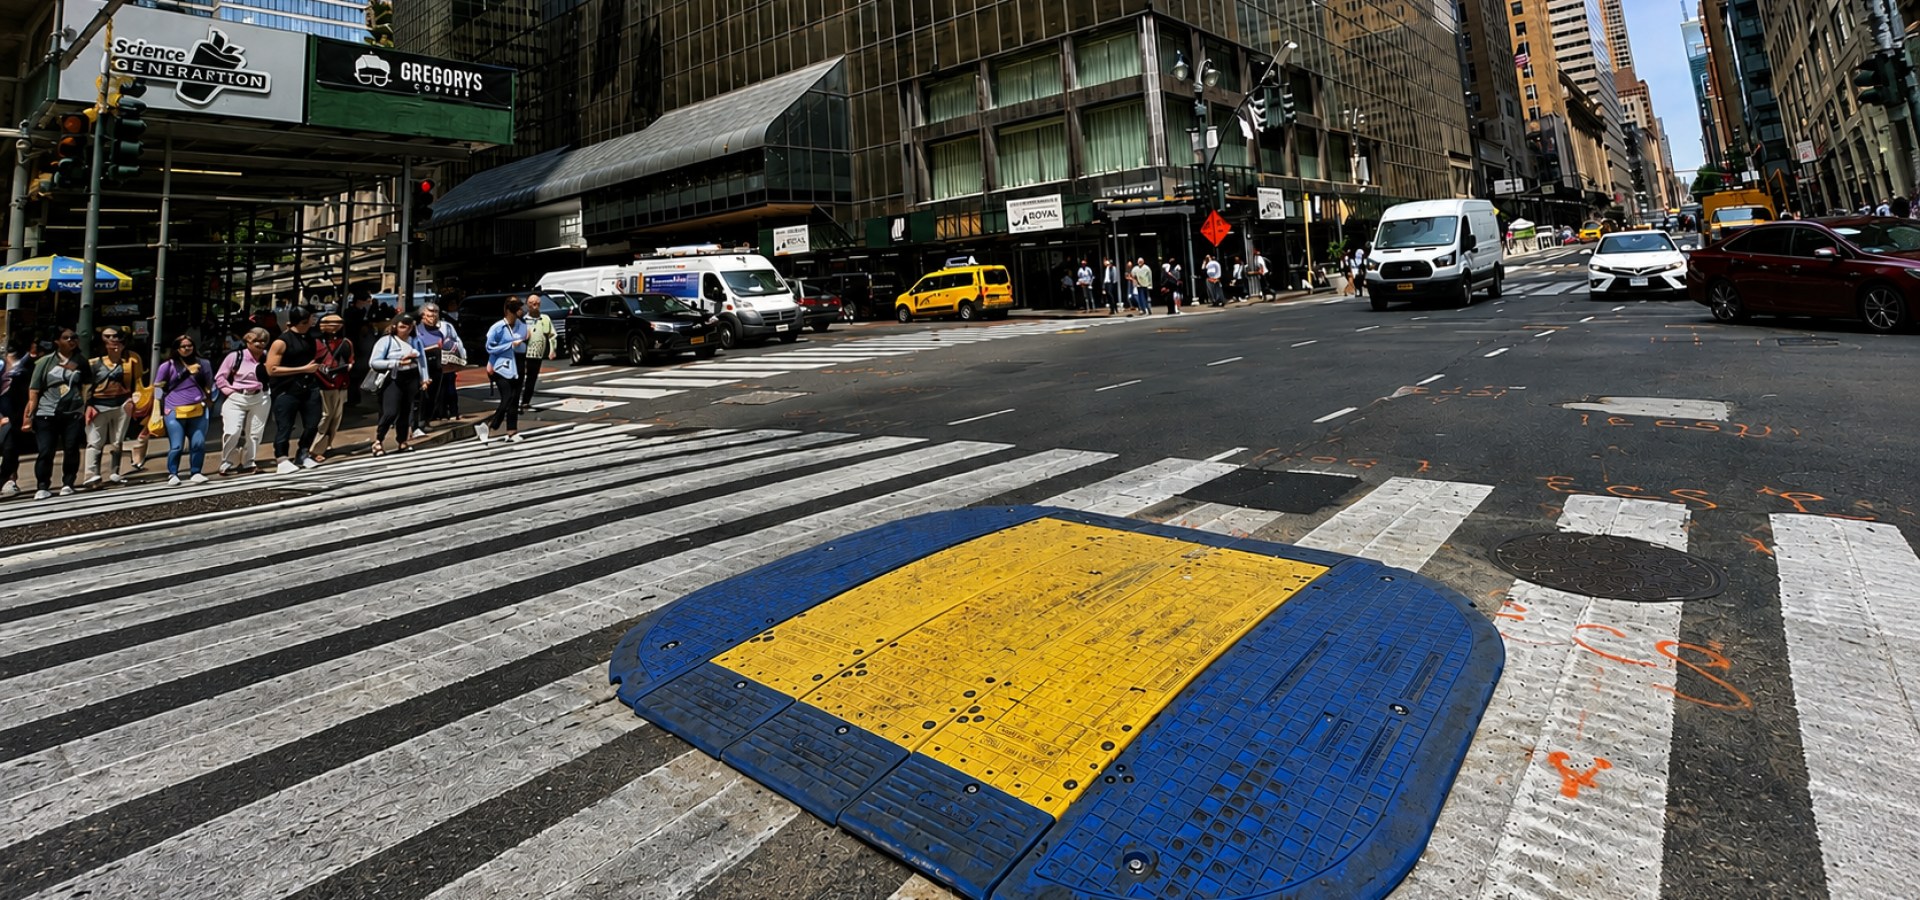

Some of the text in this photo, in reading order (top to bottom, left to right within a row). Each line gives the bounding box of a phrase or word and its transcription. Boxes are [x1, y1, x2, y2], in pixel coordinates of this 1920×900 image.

[115, 38, 186, 62] Science
[400, 61, 483, 91] GREGORYS
[1028, 209, 1058, 220] ROYAL
